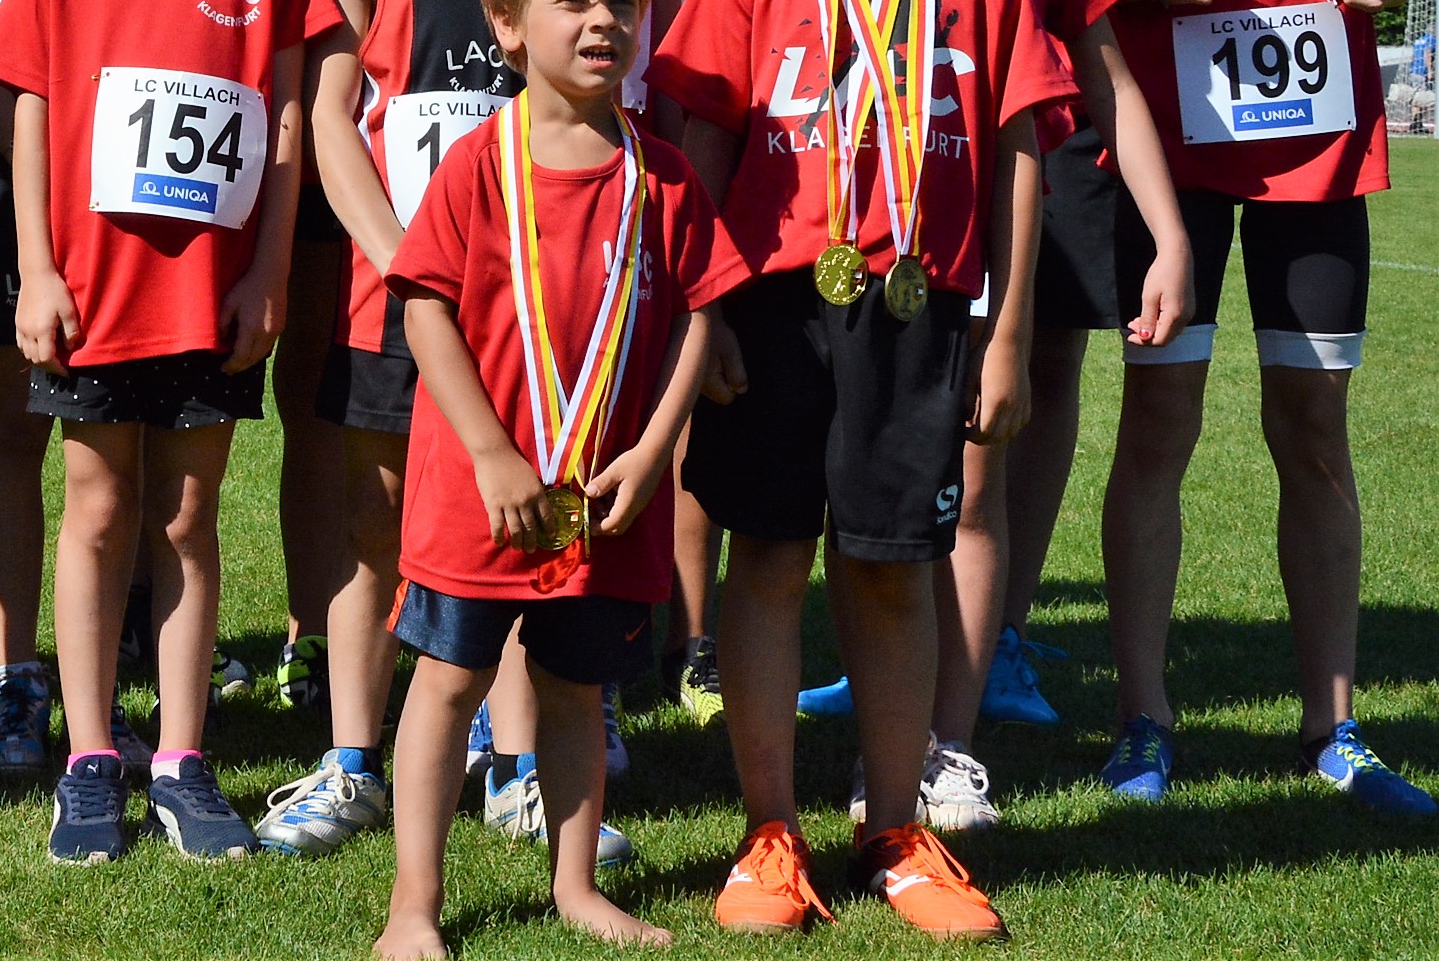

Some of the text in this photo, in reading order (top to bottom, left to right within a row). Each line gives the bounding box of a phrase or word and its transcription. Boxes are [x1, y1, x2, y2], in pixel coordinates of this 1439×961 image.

[196, 0, 261, 27] KLAGENFURT
[1211, 13, 1316, 34] LC VILLACH
[445, 40, 504, 71] LAC
[1212, 30, 1329, 101] 199
[134, 79, 240, 106] LC VILLACH
[419, 102, 503, 118] LC VILLA
[1262, 108, 1306, 121] UNIQA
[128, 98, 244, 183] 154
[164, 185, 210, 203] UNIQA
